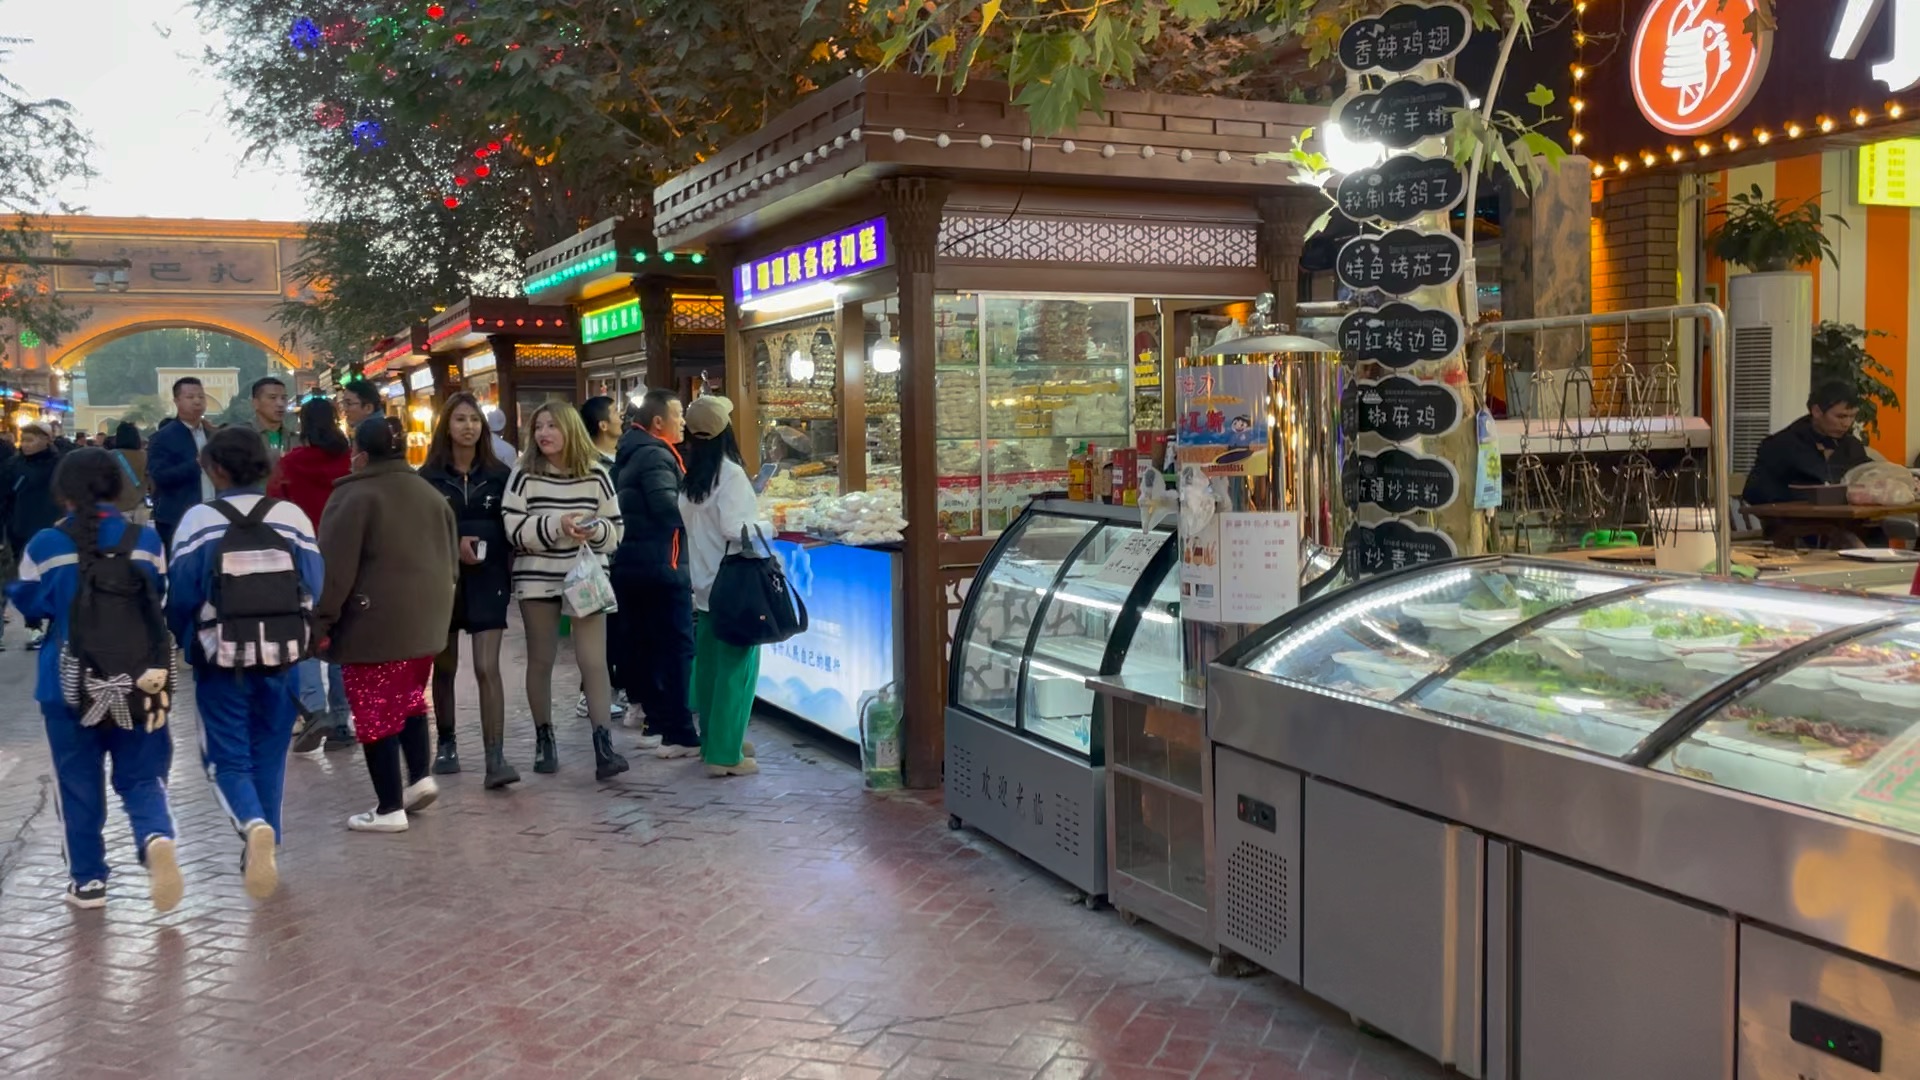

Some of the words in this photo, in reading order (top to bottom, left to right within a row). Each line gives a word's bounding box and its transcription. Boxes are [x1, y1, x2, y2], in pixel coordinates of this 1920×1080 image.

[1355, 26, 1450, 66] 香辣鸡翅
[1353, 105, 1448, 136] 孜然羊排
[1345, 179, 1449, 210] 秘制烤鸽子
[1345, 253, 1452, 280] 特色烤茄子
[1344, 327, 1448, 353] 网红梭边鱼
[1367, 405, 1436, 430] 椒麻鸡
[981, 765, 1044, 826] 欢迎光临
